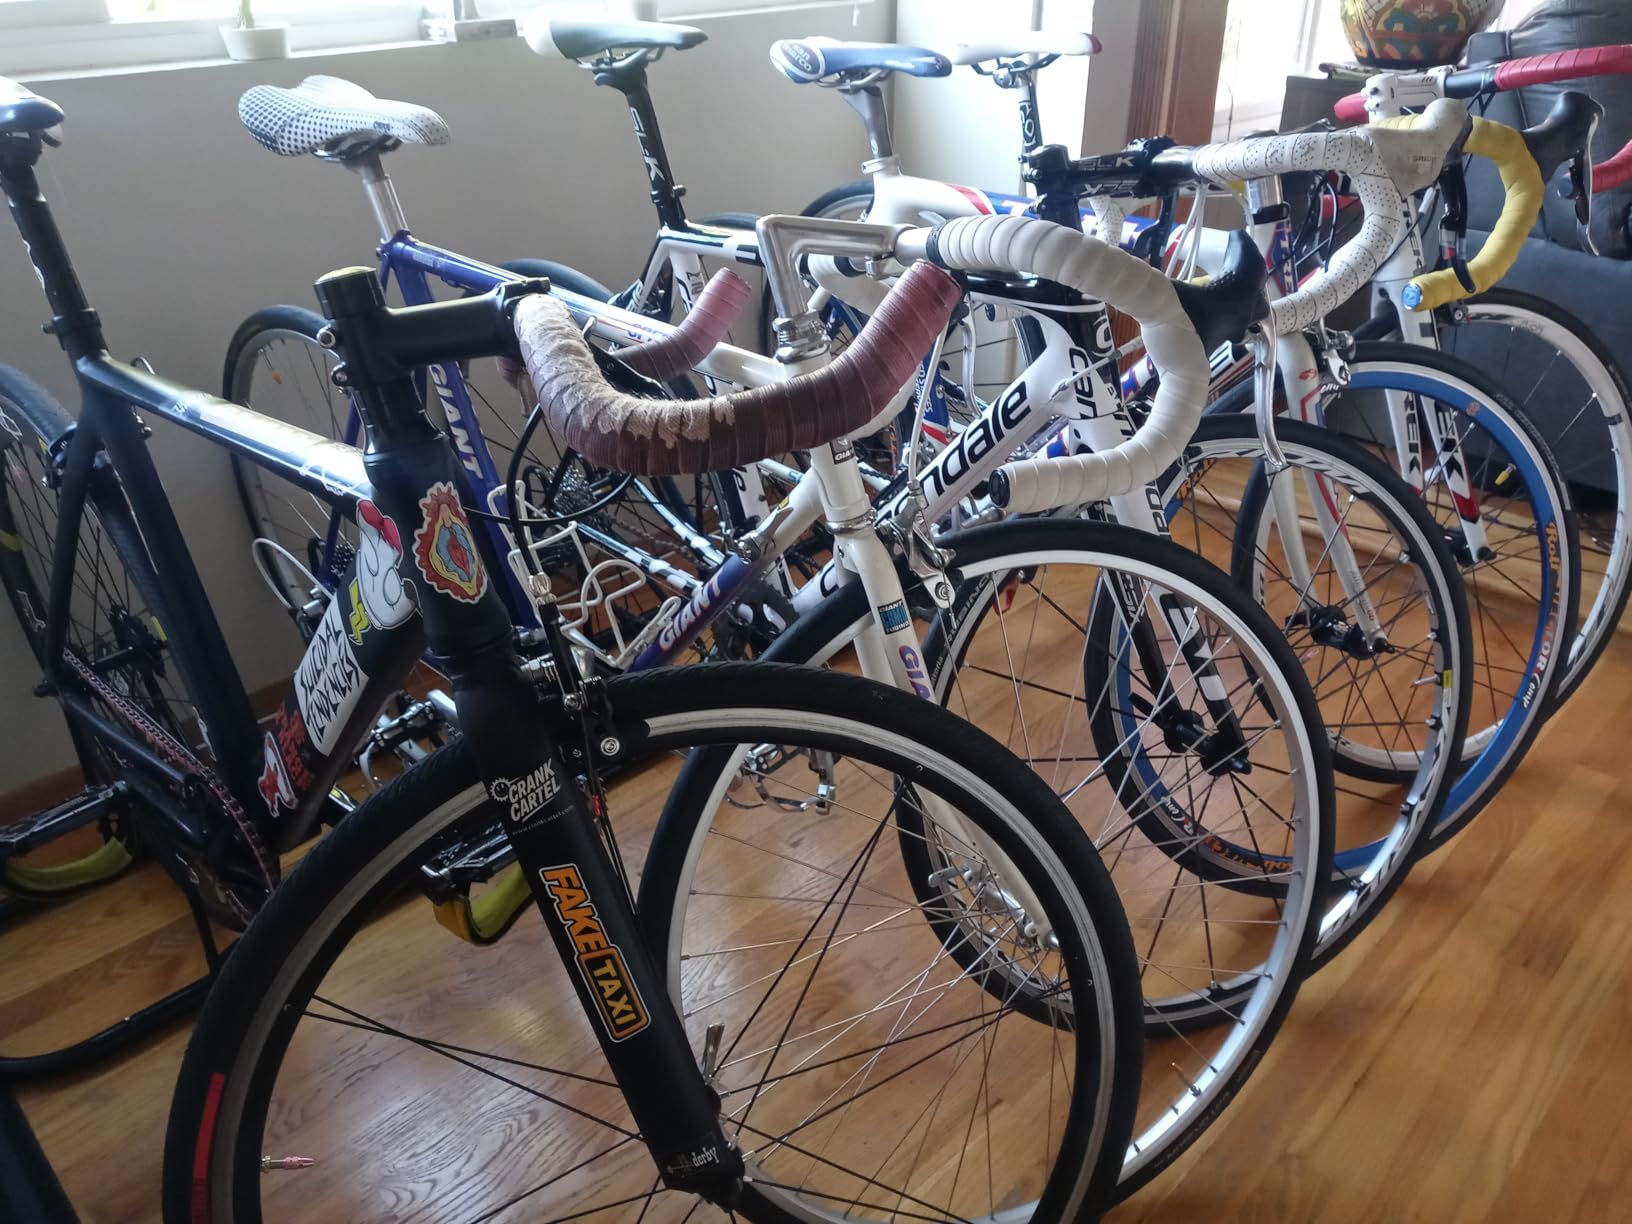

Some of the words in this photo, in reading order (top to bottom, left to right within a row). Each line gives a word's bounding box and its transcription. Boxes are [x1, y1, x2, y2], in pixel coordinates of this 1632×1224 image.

[427, 364, 483, 479] GIANT
[660, 567, 724, 651] GIANT
[300, 607, 344, 705] SUICIDAL
[307, 636, 361, 745] TENDENCIES
[508, 758, 555, 803] CRANK
[510, 776, 561, 822] CARTEL
[543, 865, 610, 953] FAKE
[593, 958, 638, 1026] TAXI
[691, 1146, 720, 1168] derby
